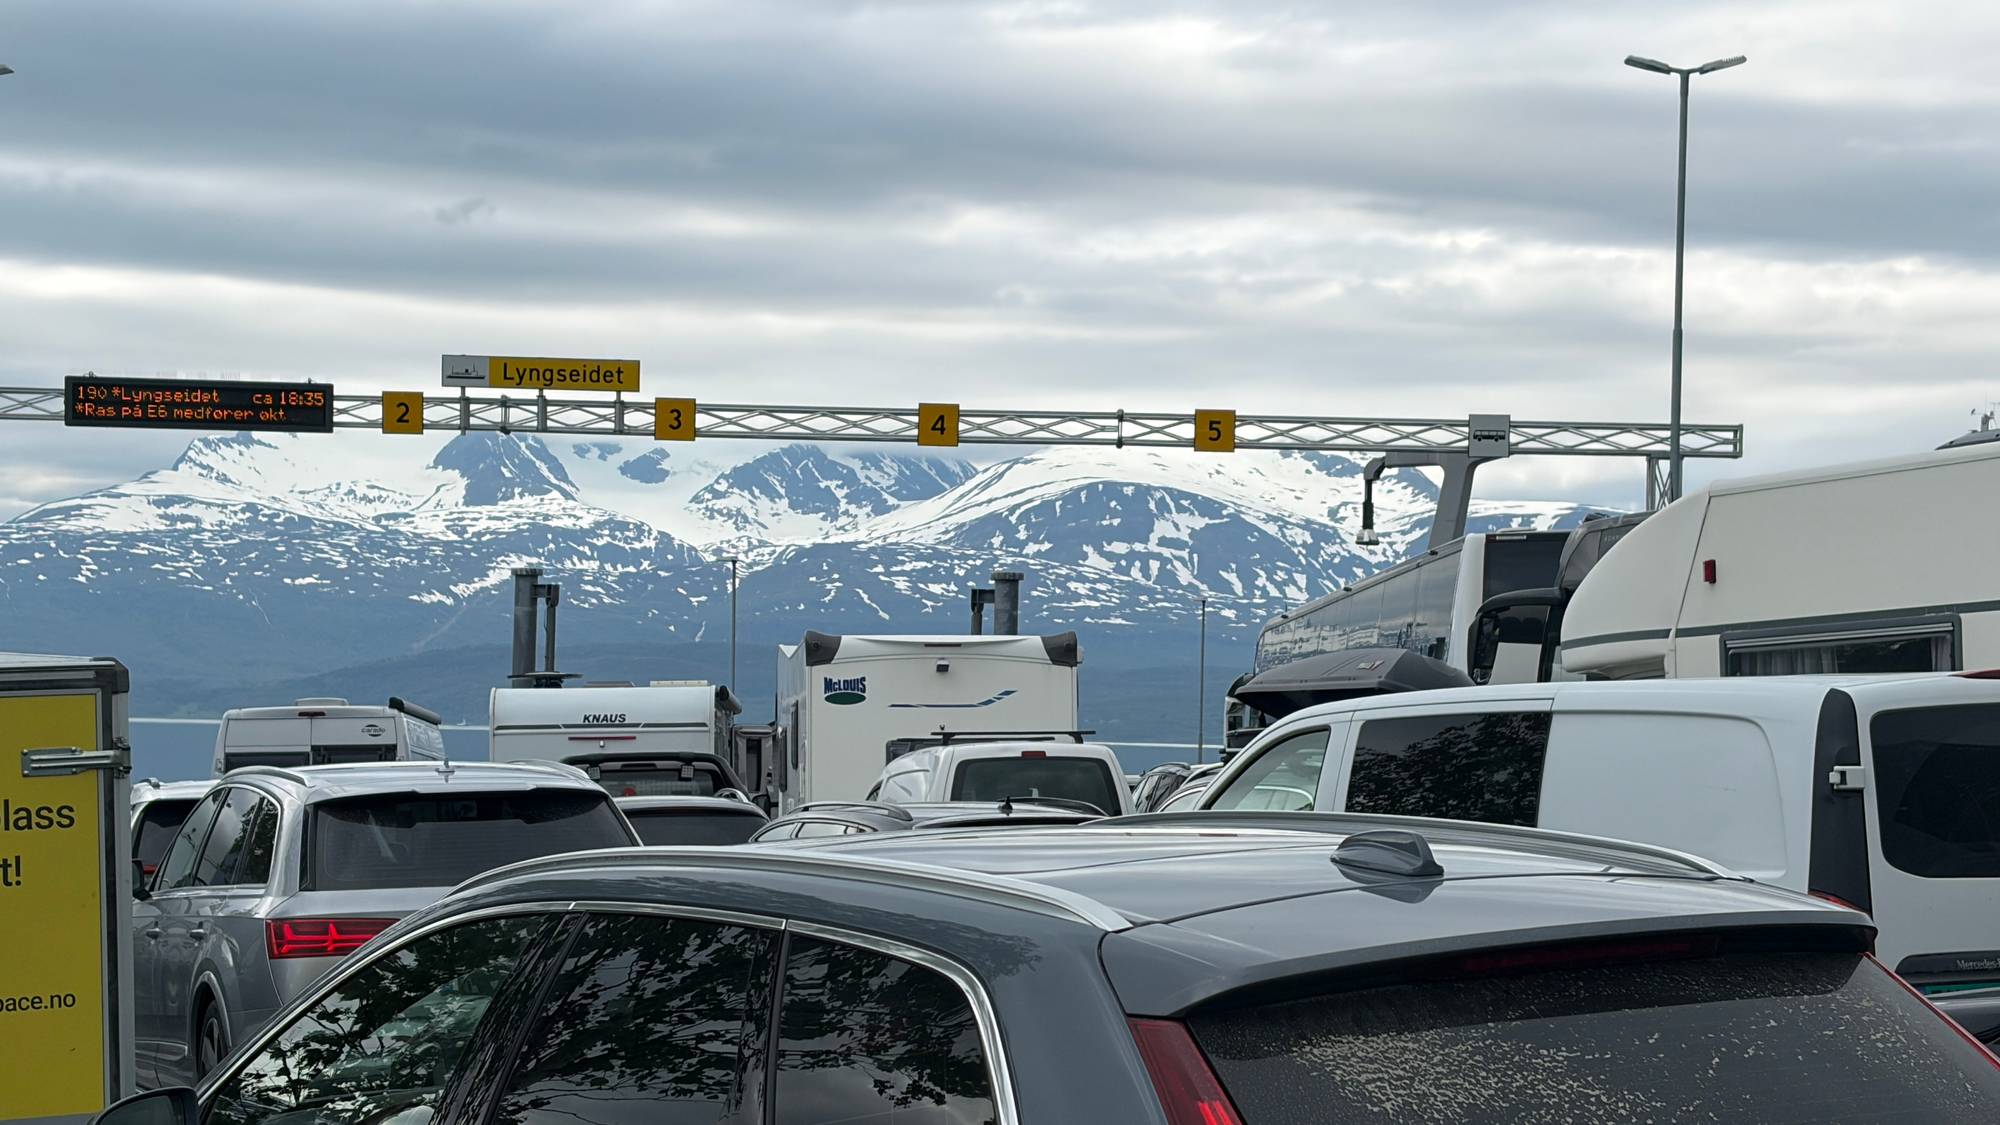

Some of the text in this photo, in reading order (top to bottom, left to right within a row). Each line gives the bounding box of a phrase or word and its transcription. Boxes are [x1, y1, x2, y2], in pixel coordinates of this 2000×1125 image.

[503, 362, 624, 386] Lyngseidet
[78, 386, 108, 400] 190
[252, 393, 273, 405] ca
[280, 391, 324, 406] 18:35
[121, 405, 142, 419] på
[147, 404, 168, 418] E6
[396, 402, 410, 424] 2
[668, 408, 682, 430] 3
[931, 414, 946, 435] 4
[1208, 420, 1222, 442] 5
[583, 713, 626, 723] KNAUS
[0, 799, 75, 831] lass
